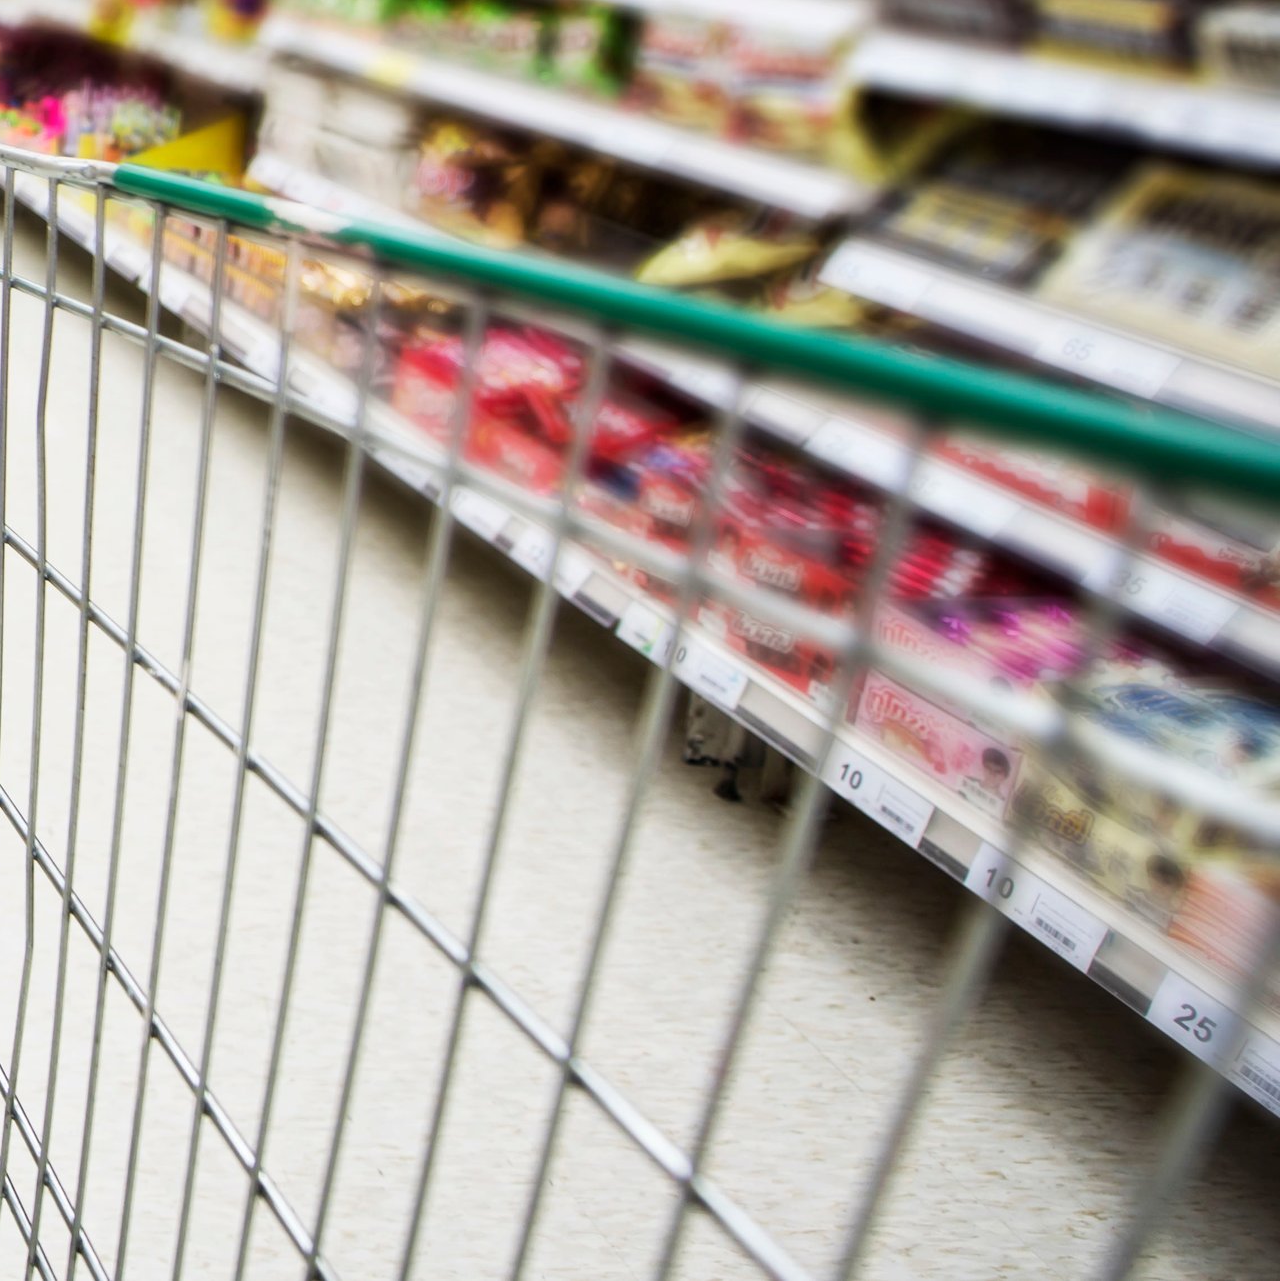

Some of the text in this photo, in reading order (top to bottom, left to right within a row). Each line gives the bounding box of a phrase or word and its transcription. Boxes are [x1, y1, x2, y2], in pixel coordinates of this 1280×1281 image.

[1060, 334, 1098, 364] 65
[662, 639, 688, 665] 10
[839, 761, 864, 792] 10
[985, 866, 1016, 901] 10
[1172, 1002, 1218, 1044] 25
